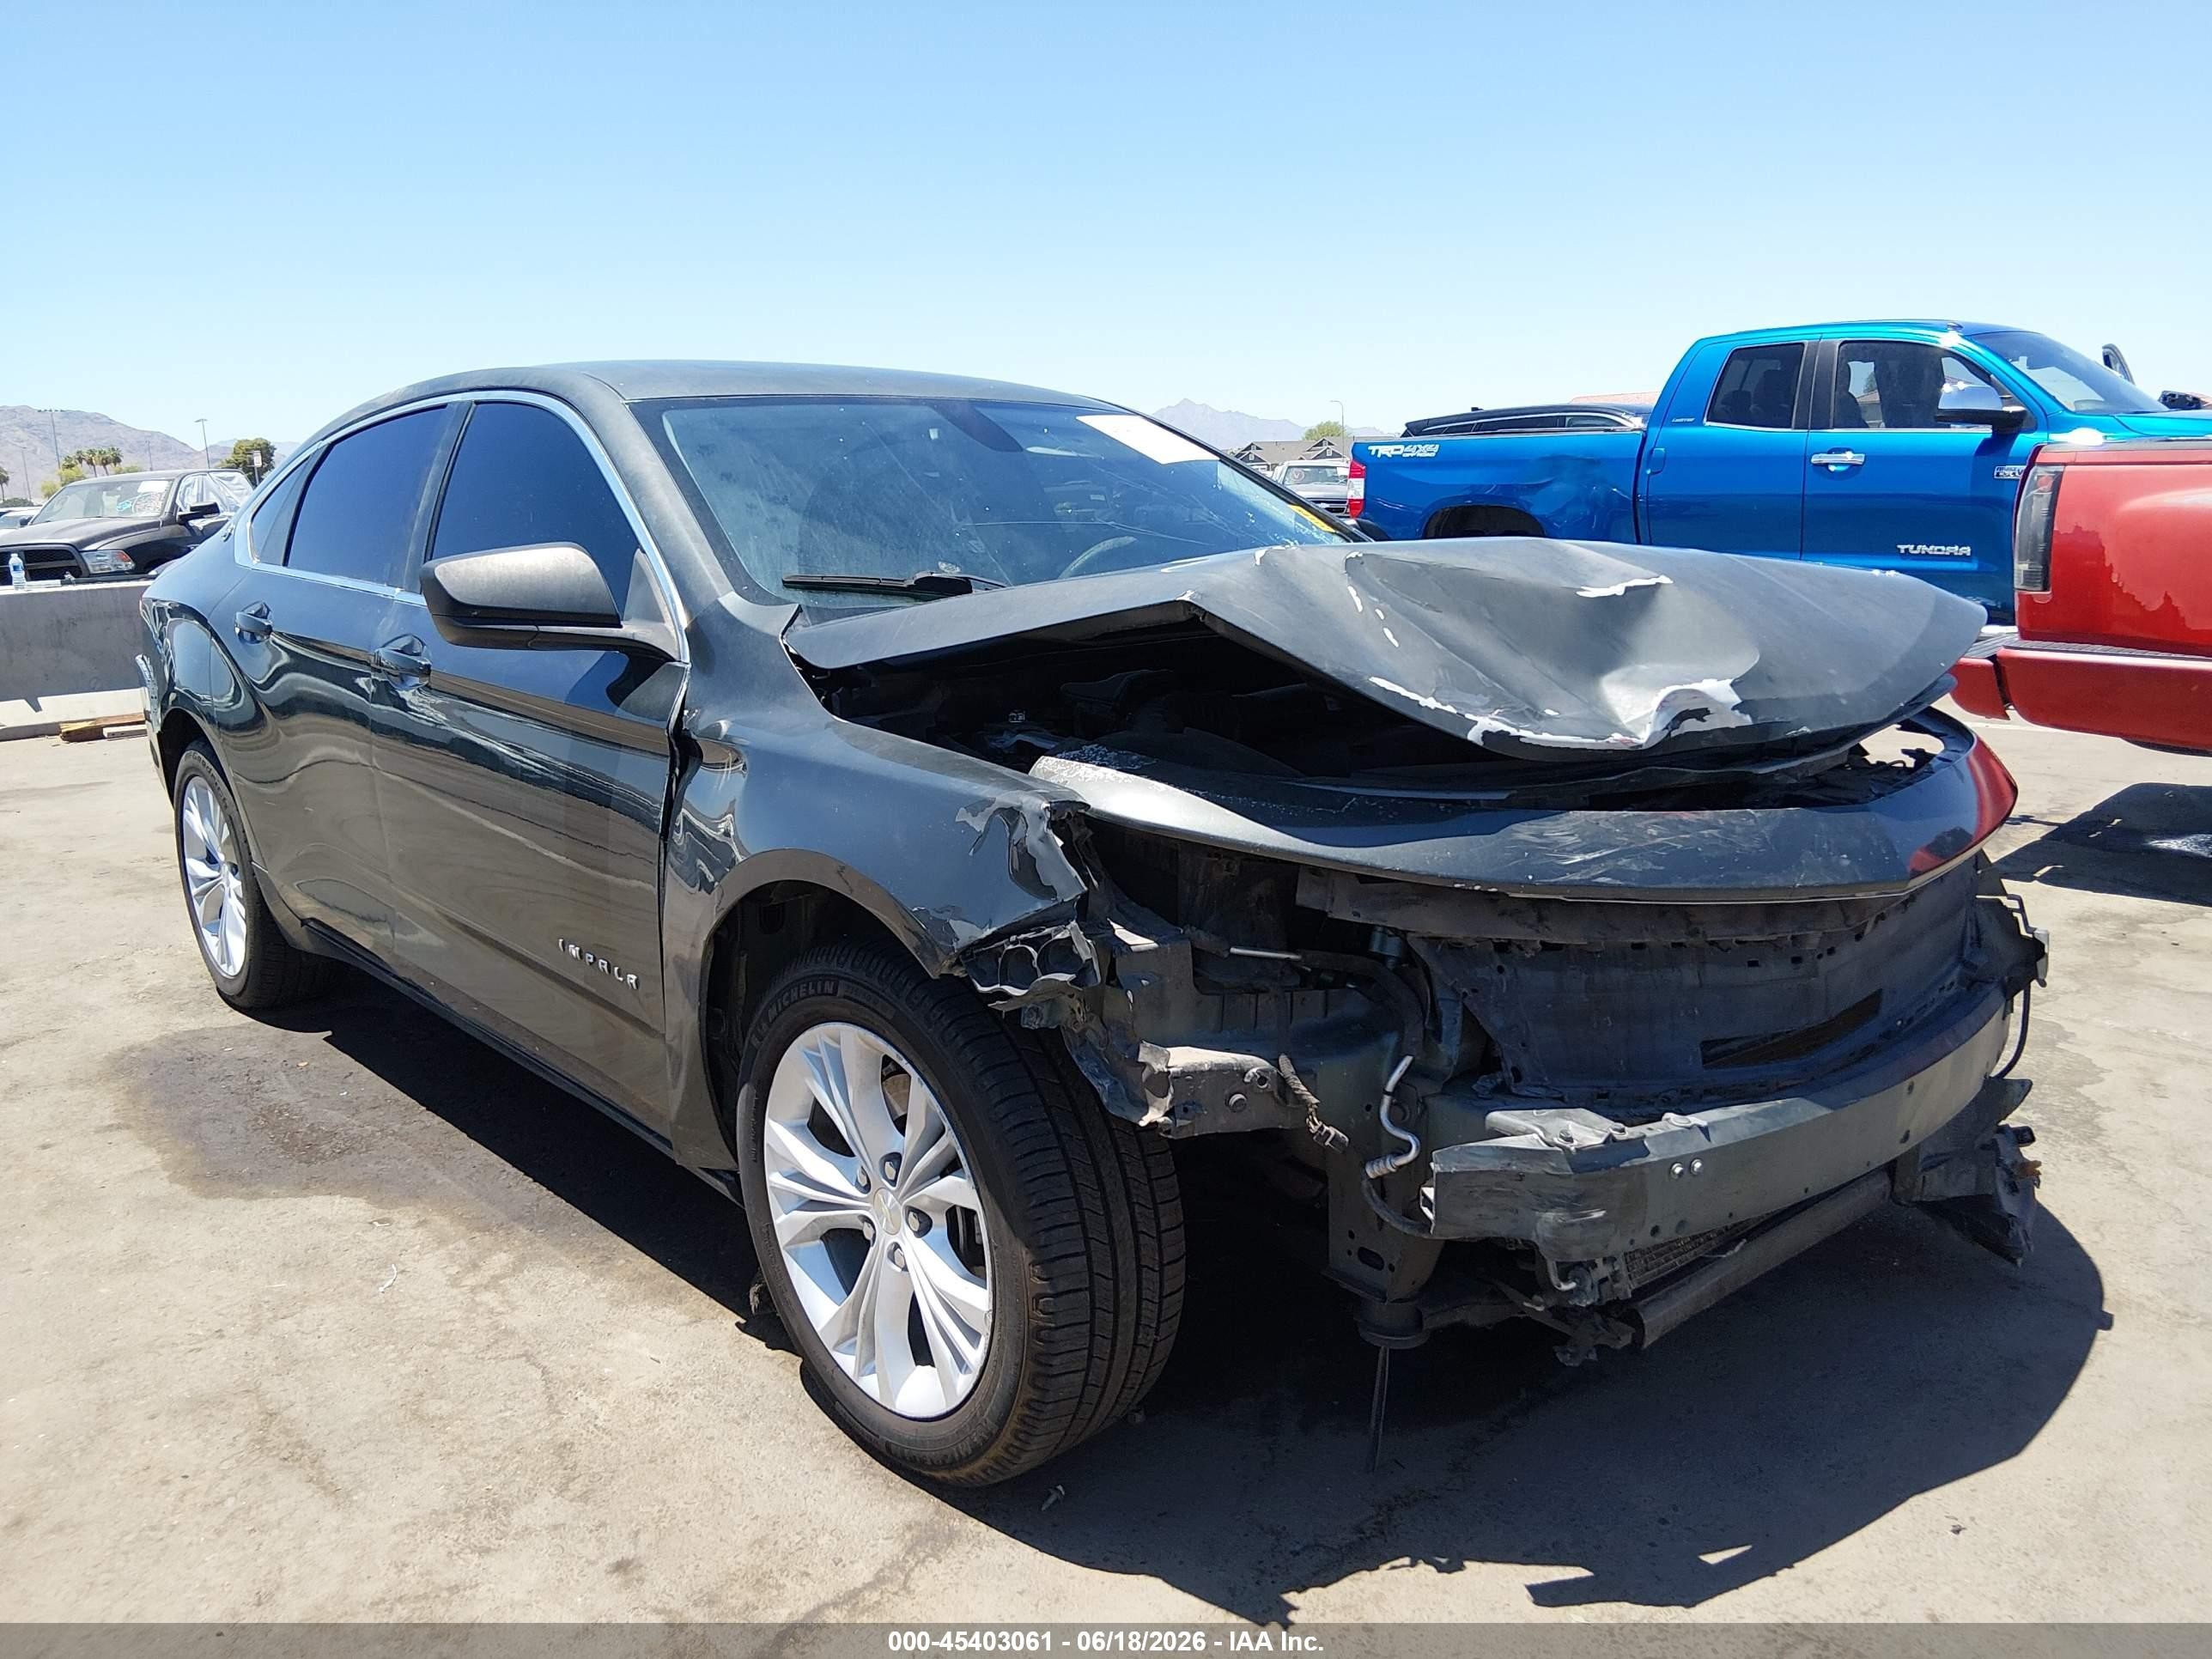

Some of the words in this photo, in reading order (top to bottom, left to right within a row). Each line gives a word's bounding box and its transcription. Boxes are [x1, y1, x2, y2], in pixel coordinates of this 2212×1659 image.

[1368, 445, 1405, 458] TRD
[1896, 544, 1972, 556] TUNDRA
[558, 938, 638, 990] IMPALA
[768, 981, 836, 1023] MICHELIN
